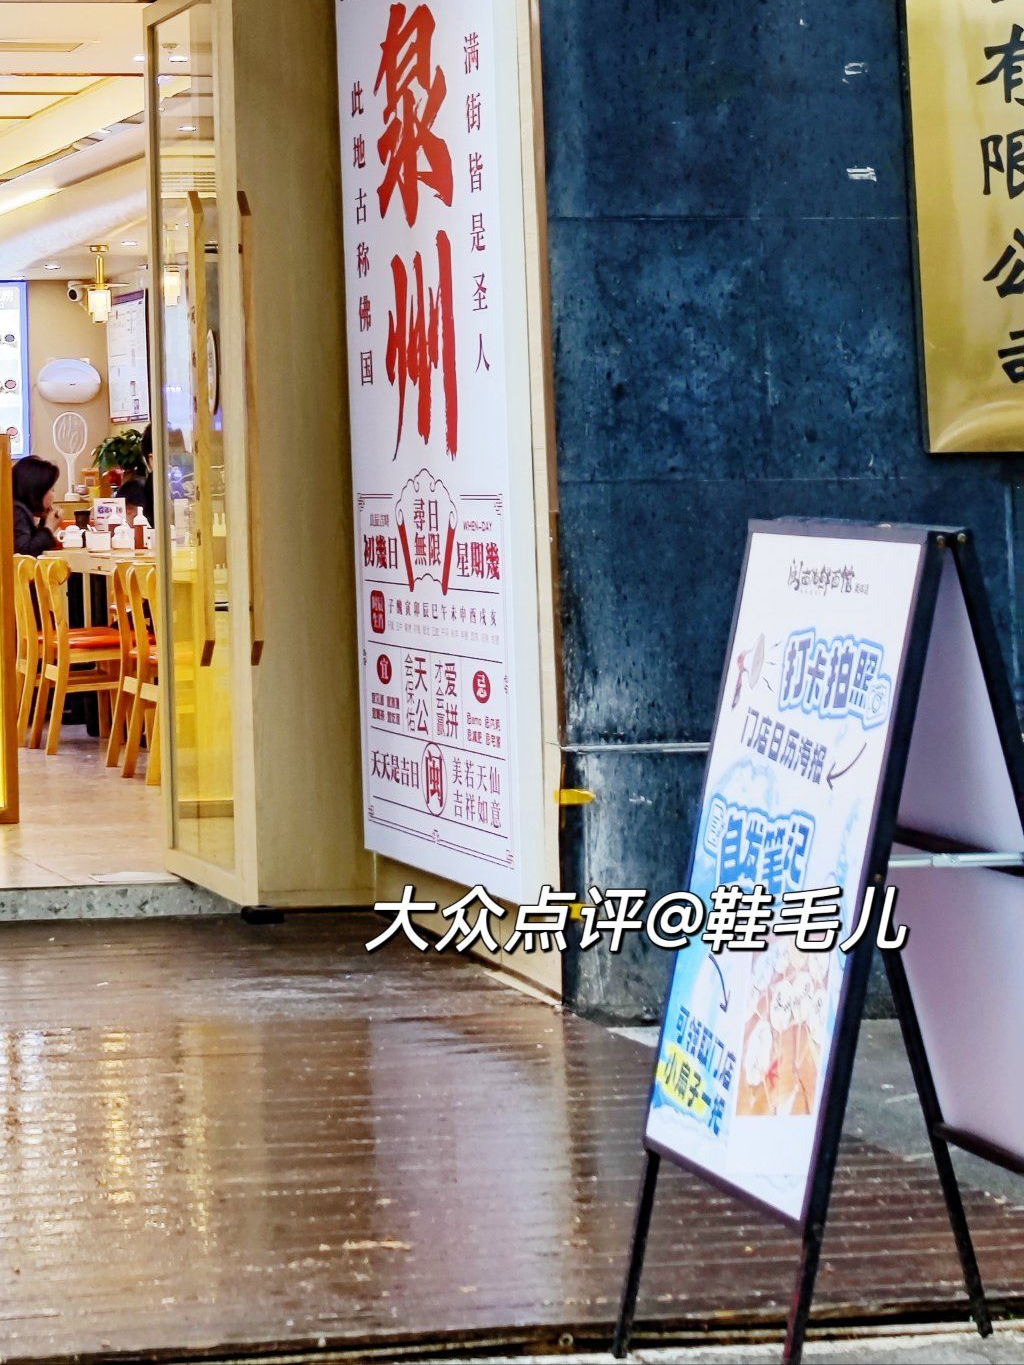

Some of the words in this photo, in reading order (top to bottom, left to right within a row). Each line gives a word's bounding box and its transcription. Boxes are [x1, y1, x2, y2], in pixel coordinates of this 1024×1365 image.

[350, 80, 376, 387] 此地古称佛国
[373, 2, 458, 462] 泉州
[462, 31, 491, 374] 满街皆是圣人
[414, 656, 429, 735] 天公
[444, 662, 459, 740] 爱拼
[782, 637, 880, 710] 打卡拍照
[425, 750, 444, 808] 闽
[452, 756, 501, 795] 美若天仙
[740, 706, 828, 786] 门店日历海报
[453, 789, 502, 829] 吉祥如意
